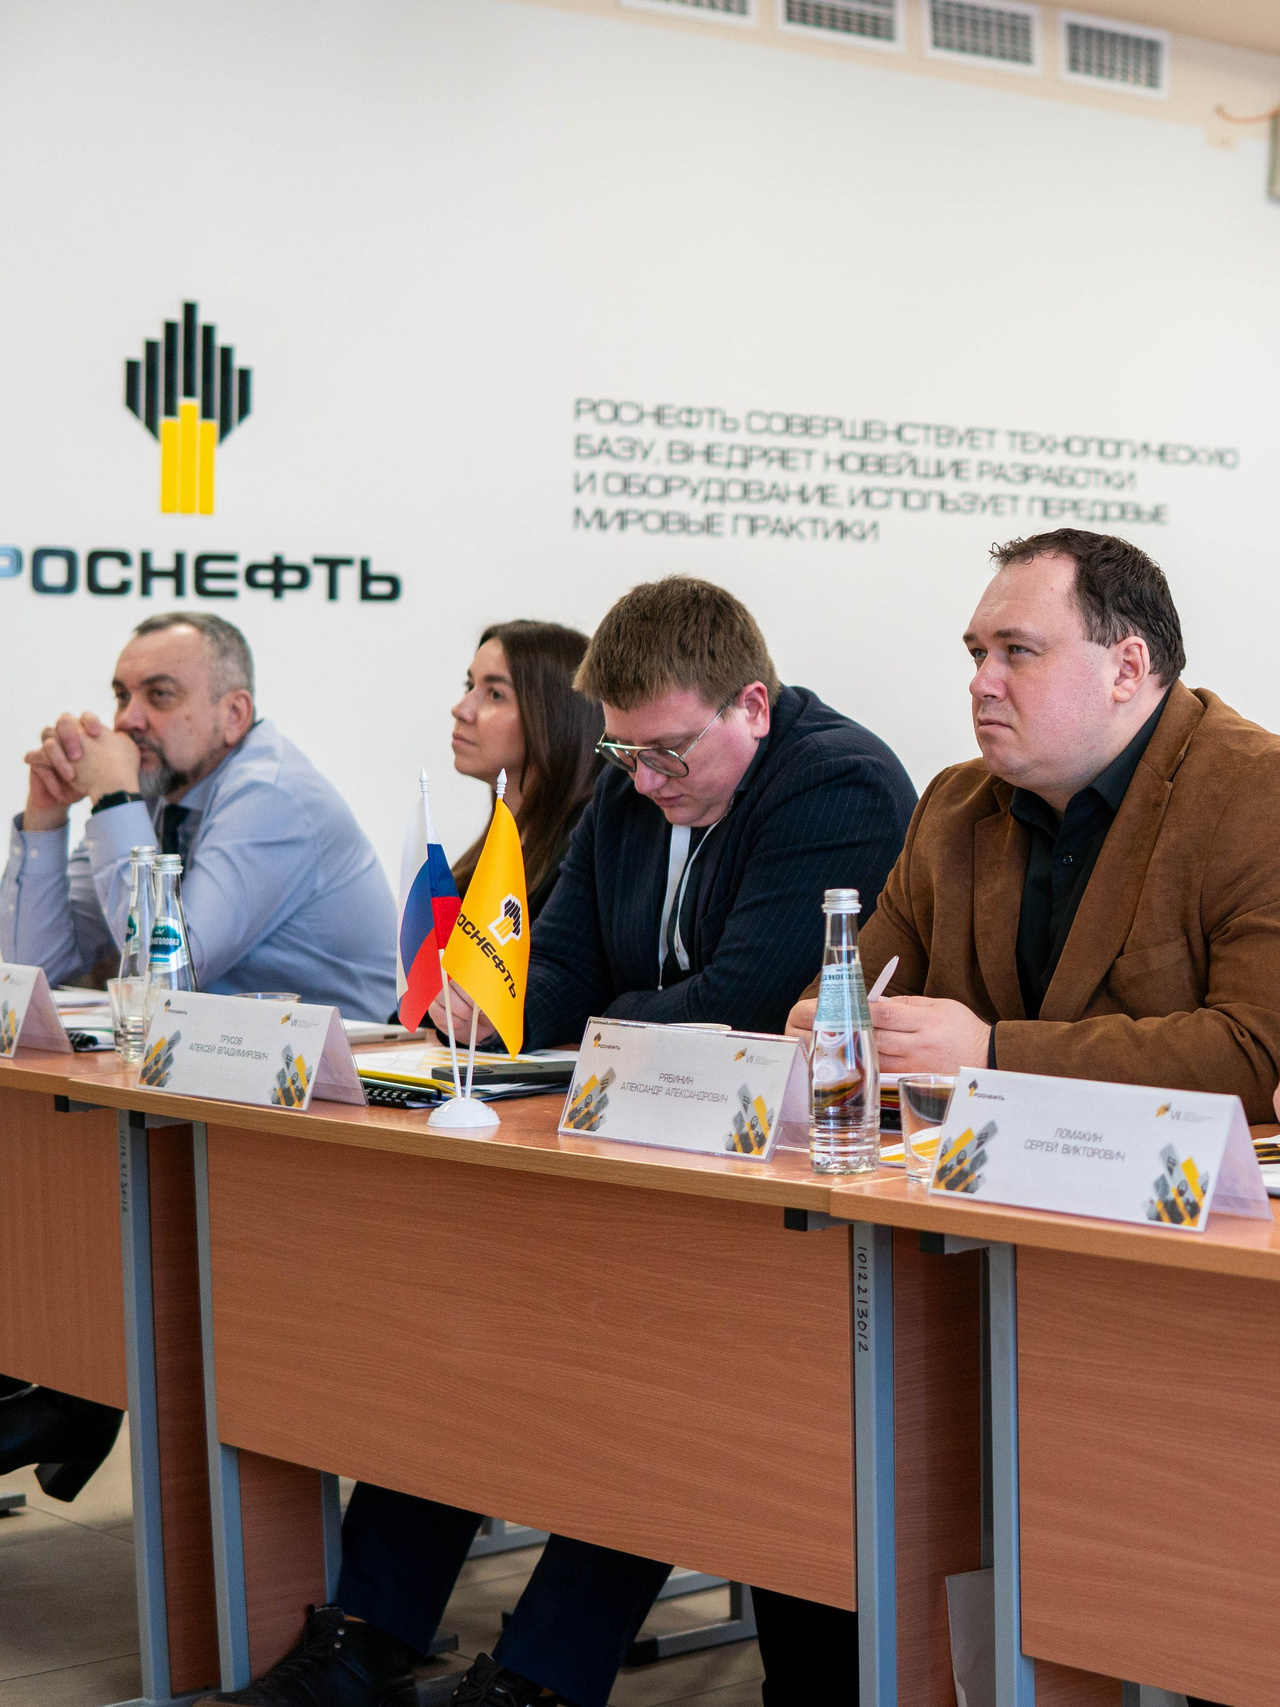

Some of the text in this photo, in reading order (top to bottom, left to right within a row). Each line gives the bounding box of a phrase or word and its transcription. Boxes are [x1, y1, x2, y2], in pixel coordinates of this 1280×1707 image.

[574, 397, 1239, 470] РОСНЕФТЬ СОВЕРШЕНСТВУЕТ ТЕХНОЛОГИЧЕСКУЮ
[667, 440, 816, 472] ВНЕДРЯЕТ
[824, 450, 971, 482] НОВЕЙШИЕ
[977, 460, 1137, 491] РАЗРАБОТКИ
[573, 471, 597, 494] И
[849, 486, 1022, 518] ИСПОЛЬЗУЕТ
[1028, 495, 1170, 526] ПЕРЕДОВЫЕ
[573, 506, 880, 542] МИРОВЫЕ ПРАКТИКИ
[456, 912, 517, 999] ОСНЕФТЬ
[188, 1042, 216, 1053] АЛЕКСЕЙ
[620, 1081, 729, 1103] АЛЕКСАНДР АЛЕКСАНДРОВИЧ
[659, 1072, 694, 1085] РЯБИНИН
[1024, 1138, 1127, 1161] СЕРГЕЙ ВИКТОРОВИЧ
[1054, 1127, 1103, 1143] ЛОМАКИН
[857, 1245, 869, 1353] 1012213012
